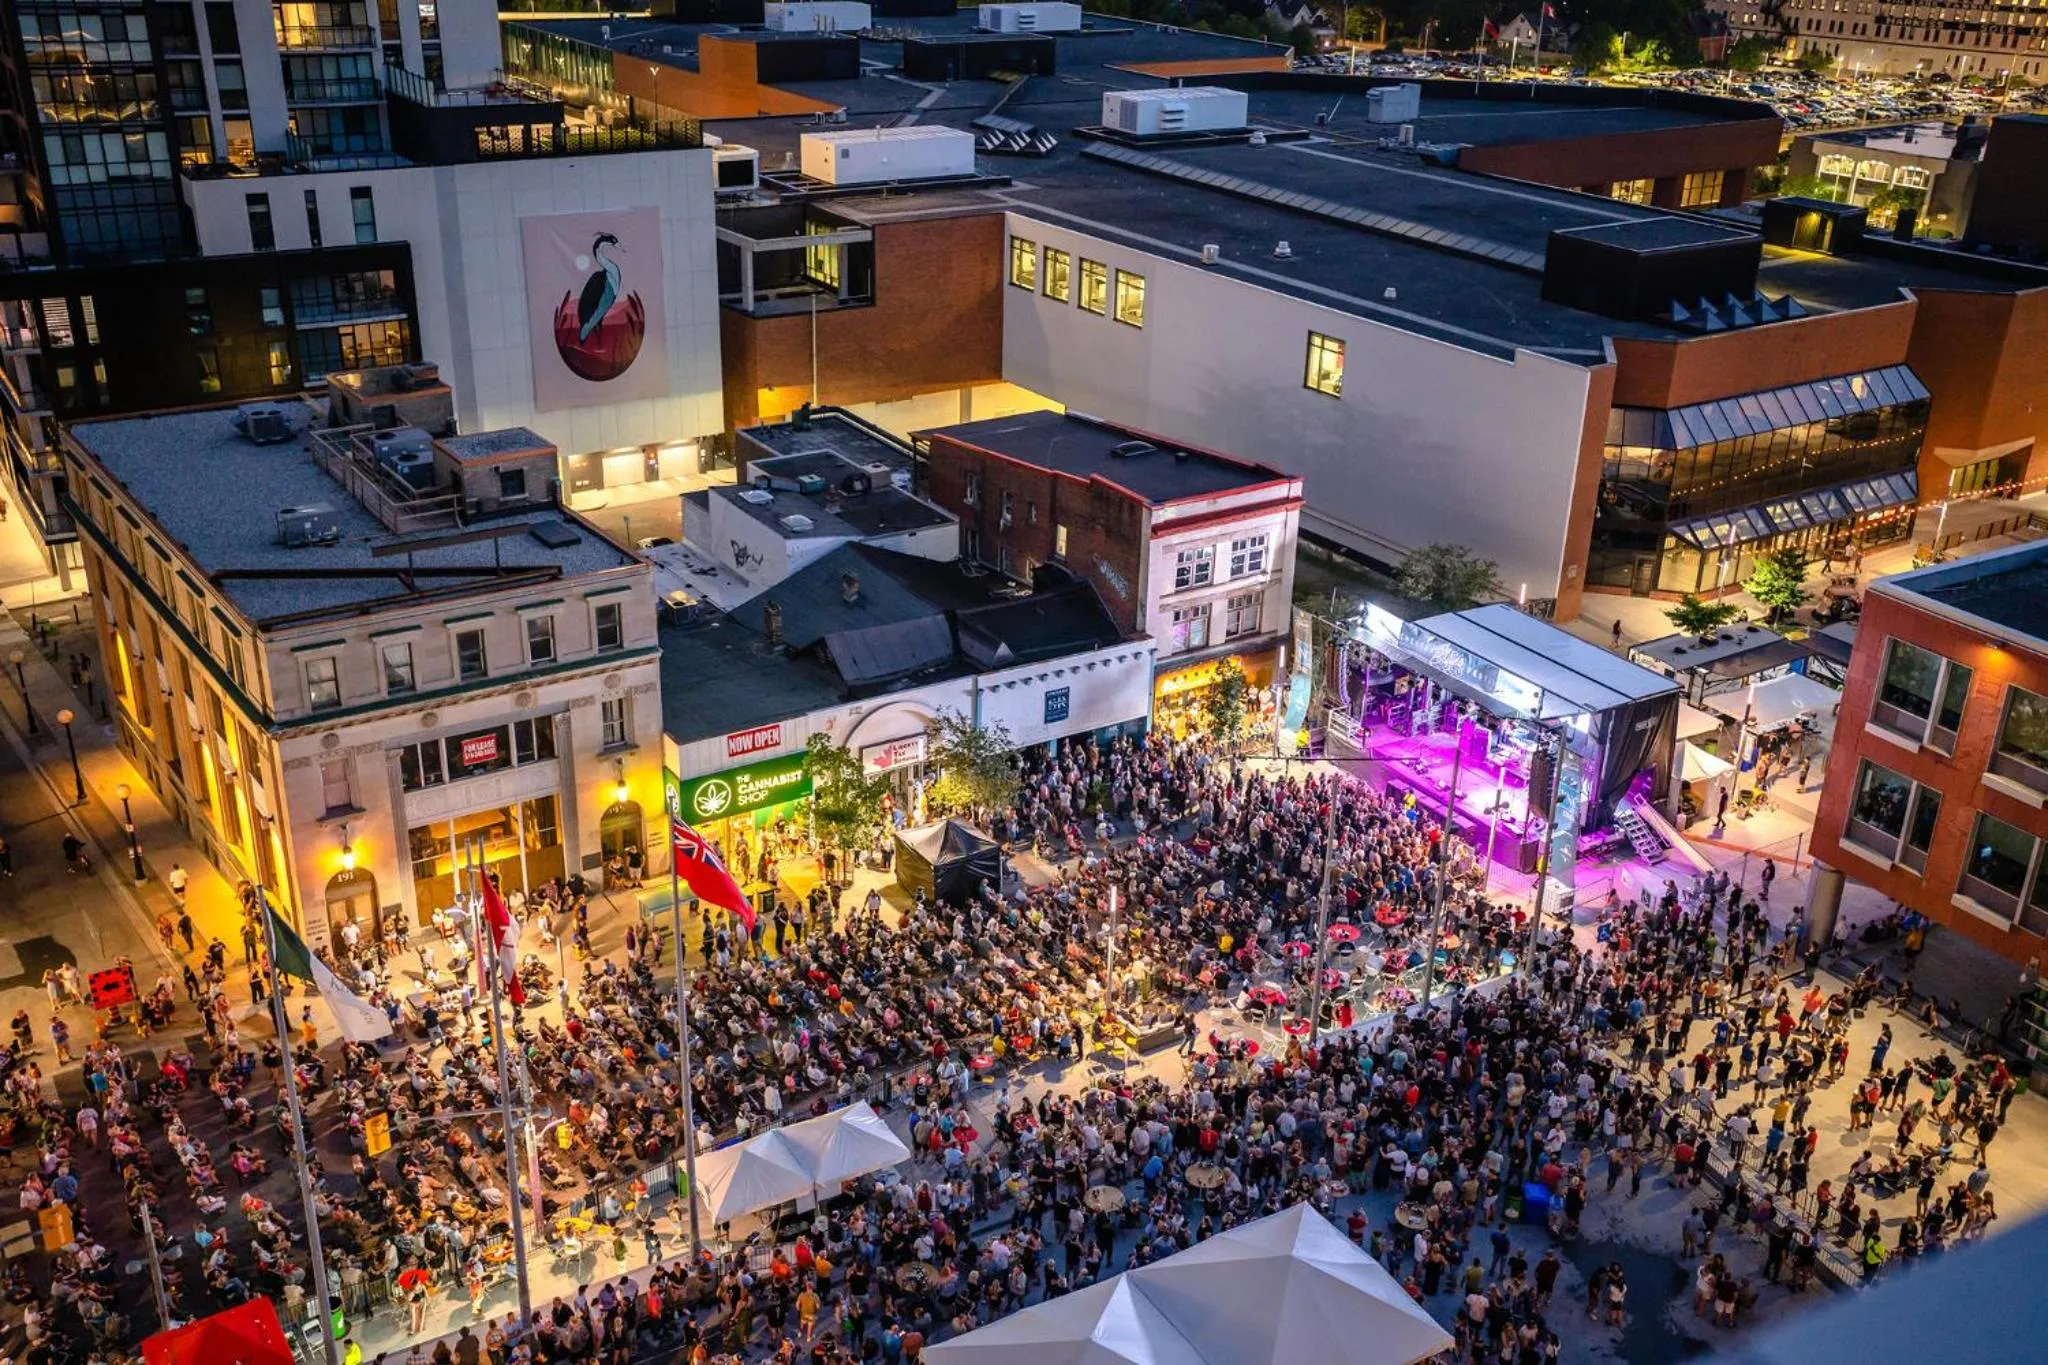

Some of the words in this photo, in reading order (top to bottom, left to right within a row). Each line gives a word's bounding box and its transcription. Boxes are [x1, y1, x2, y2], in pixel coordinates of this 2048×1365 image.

[463, 744, 476, 753] FOR
[476, 740, 496, 751] LEASE
[728, 733, 753, 754] NOW
[754, 727, 780, 747] OPEN
[736, 774, 751, 784] THE
[738, 769, 803, 794] CANNABIST
[738, 789, 769, 806] SHOP
[335, 871, 354, 883] 191
